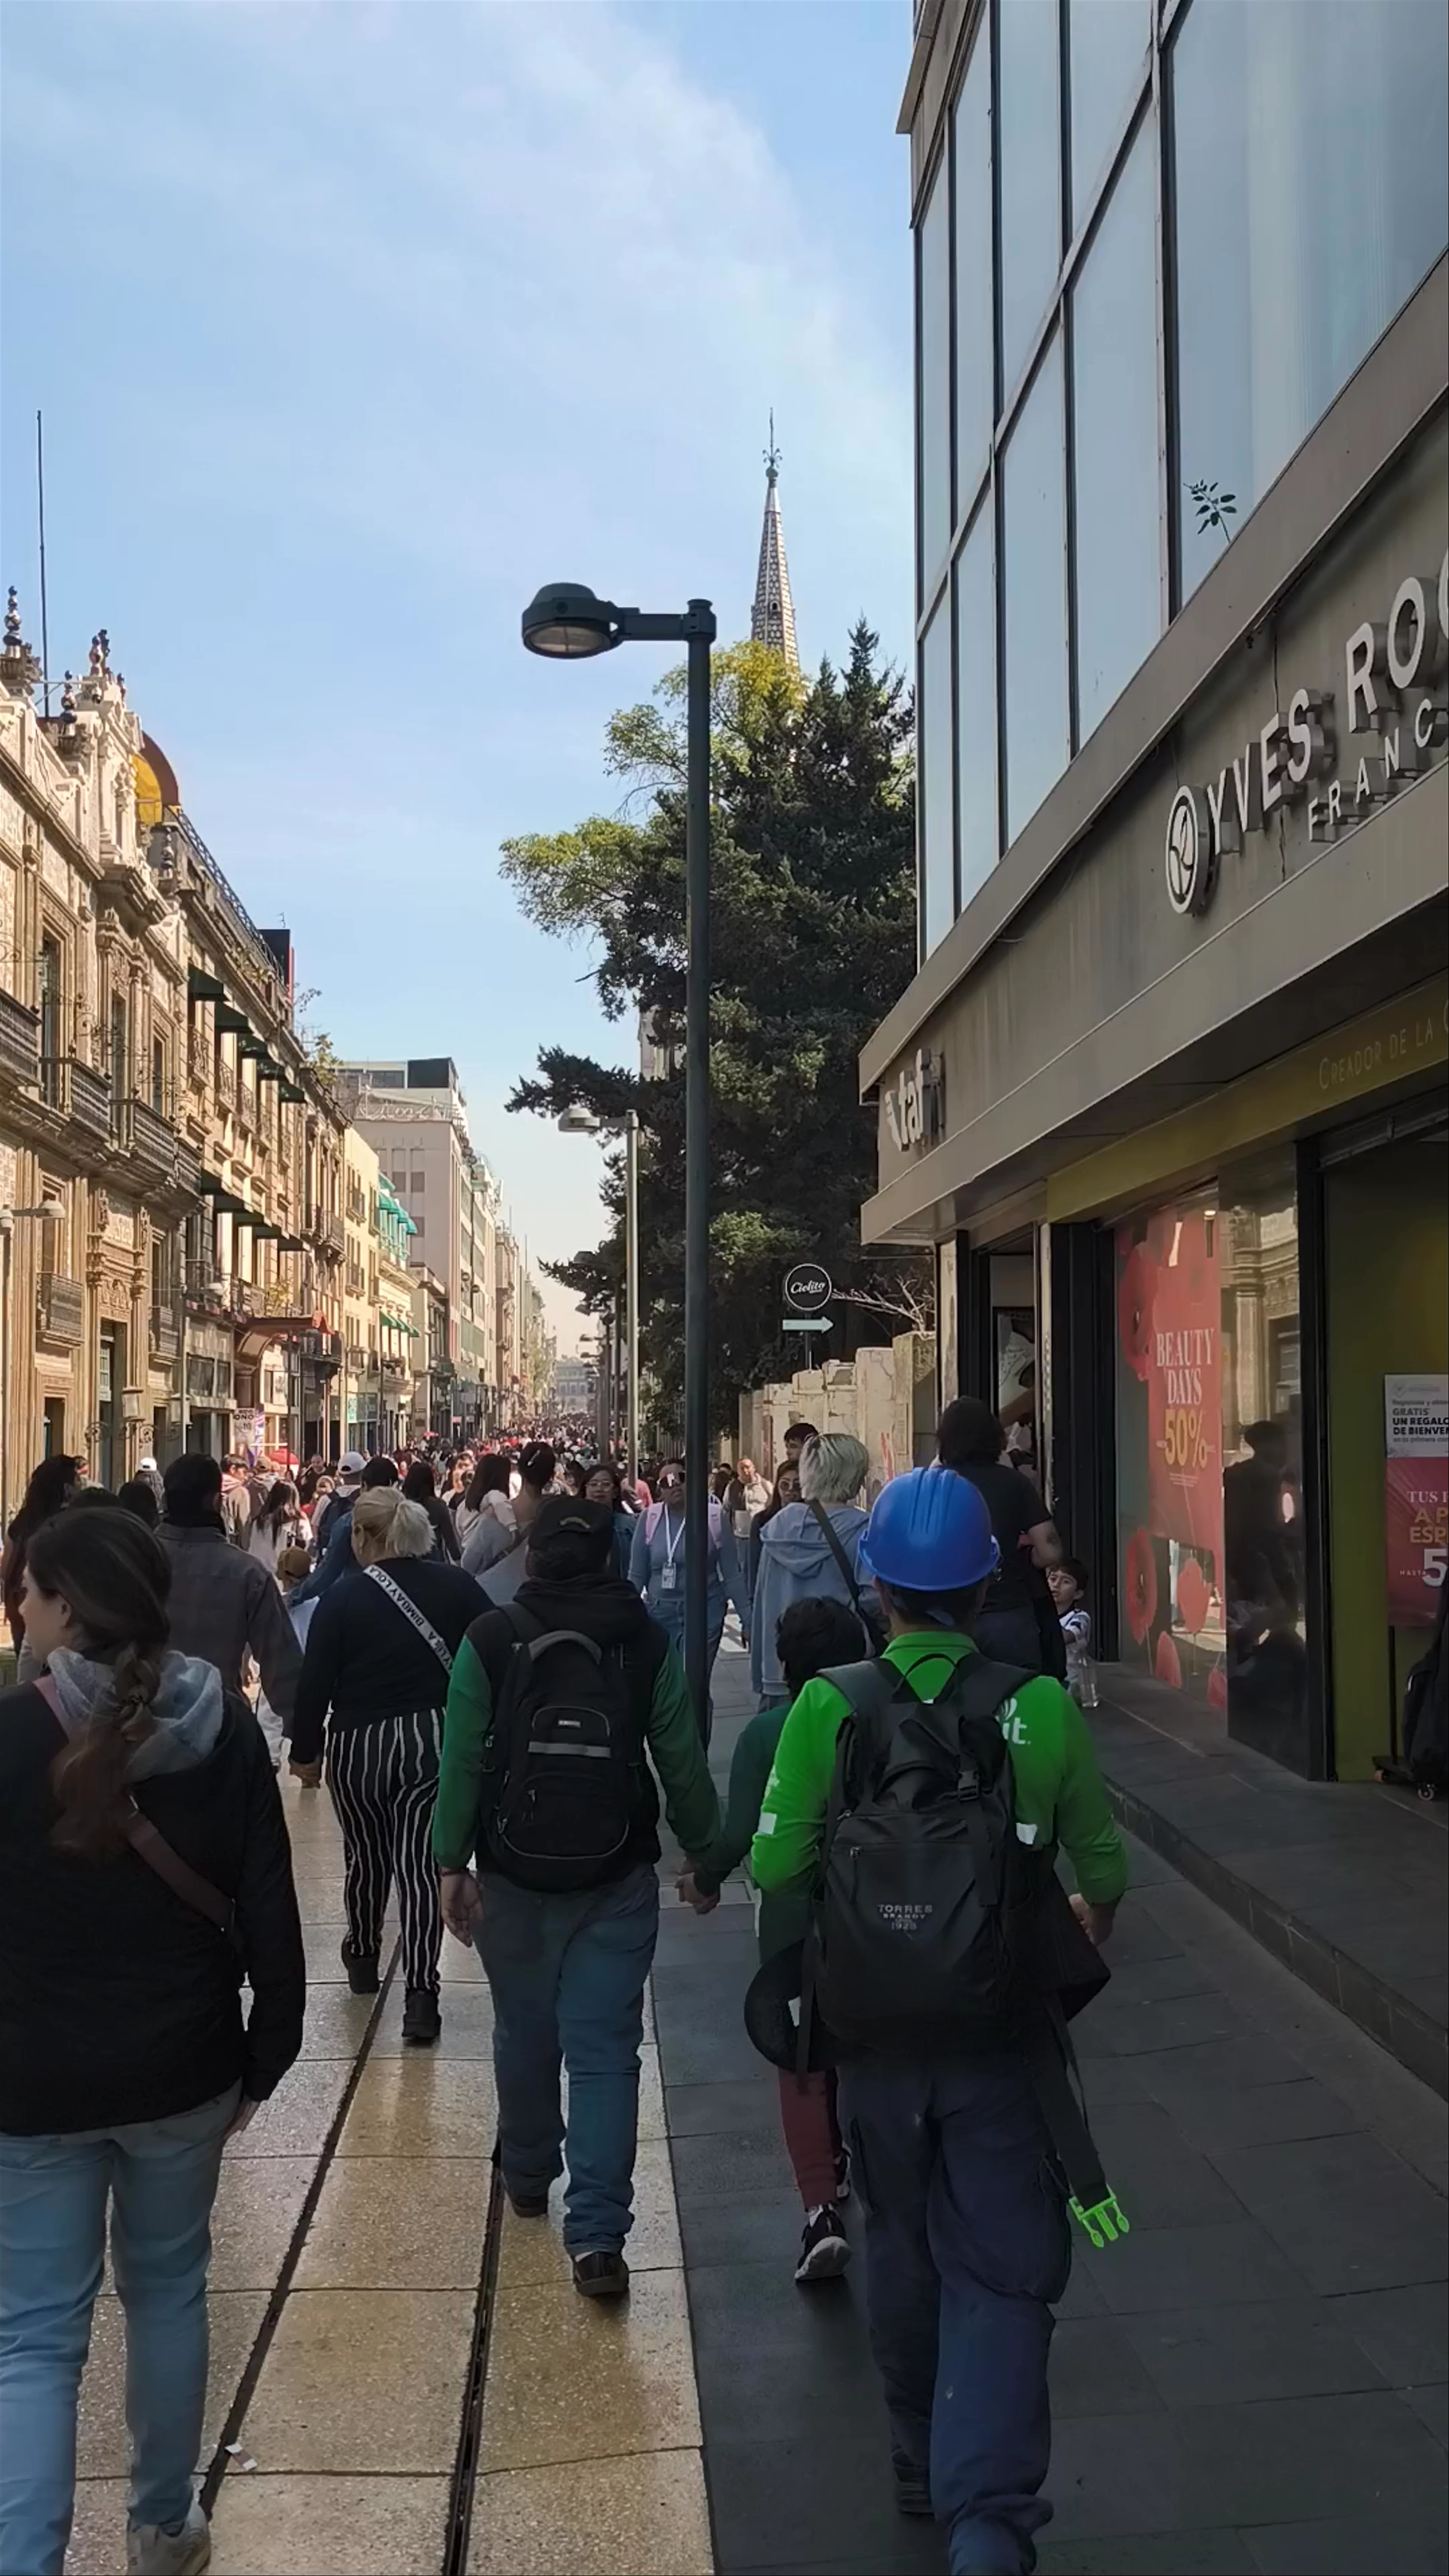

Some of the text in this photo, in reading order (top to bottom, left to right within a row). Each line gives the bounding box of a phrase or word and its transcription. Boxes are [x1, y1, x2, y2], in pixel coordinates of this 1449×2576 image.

[1207, 547, 1449, 855] YVES RO
[1308, 698, 1433, 841] FRANC
[1389, 1028, 1406, 1060] DE
[1416, 1017, 1433, 1047] LA
[1156, 1328, 1214, 1367] BEAUTY
[1167, 1368, 1202, 1405] DAYS
[1165, 1409, 1207, 1469] 50%
[1407, 1491, 1438, 1503] TUS
[1415, 1508, 1431, 1523] A
[1410, 1527, 1449, 1544] ESP
[877, 1904, 933, 1913] TORRES
